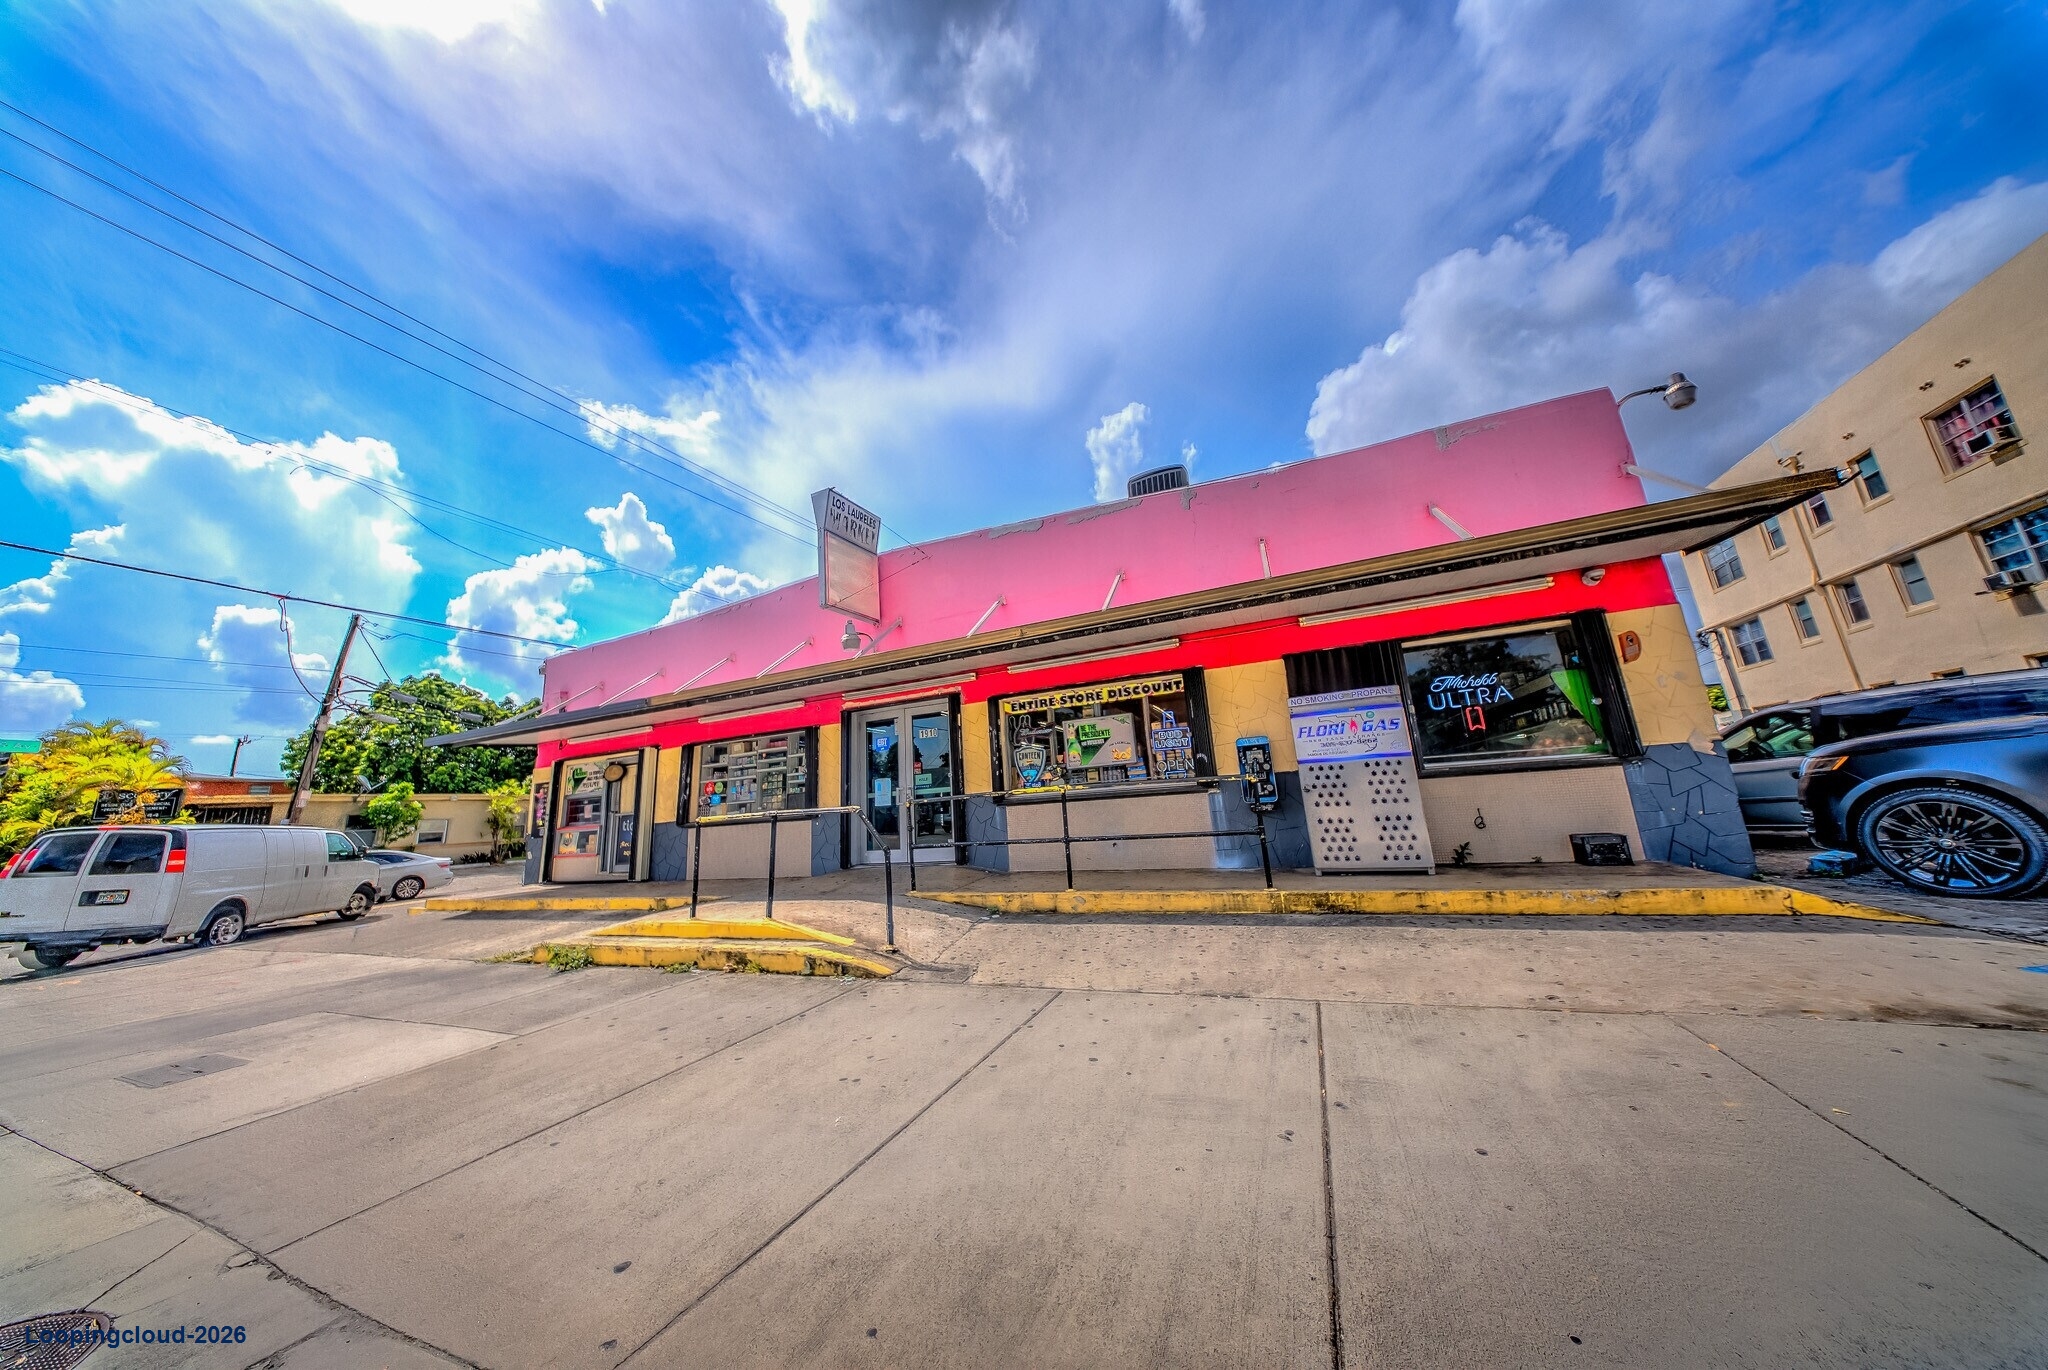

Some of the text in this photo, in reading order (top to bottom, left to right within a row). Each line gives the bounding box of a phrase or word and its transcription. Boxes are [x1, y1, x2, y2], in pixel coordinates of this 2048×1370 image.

[832, 496, 877, 530] LOS LAURELES
[1430, 672, 1499, 692] Michelob
[1011, 680, 1183, 712] ENTIRE STORE DISCOUNT
[1290, 686, 1395, 706] NO SMOKING PROPANE
[1427, 685, 1514, 711] ULTRA
[1159, 729, 1183, 740] BUD
[1297, 718, 1400, 739] FLORI GAS
[1155, 737, 1189, 749] LIGHT
[1156, 758, 1195, 773] OPEN
